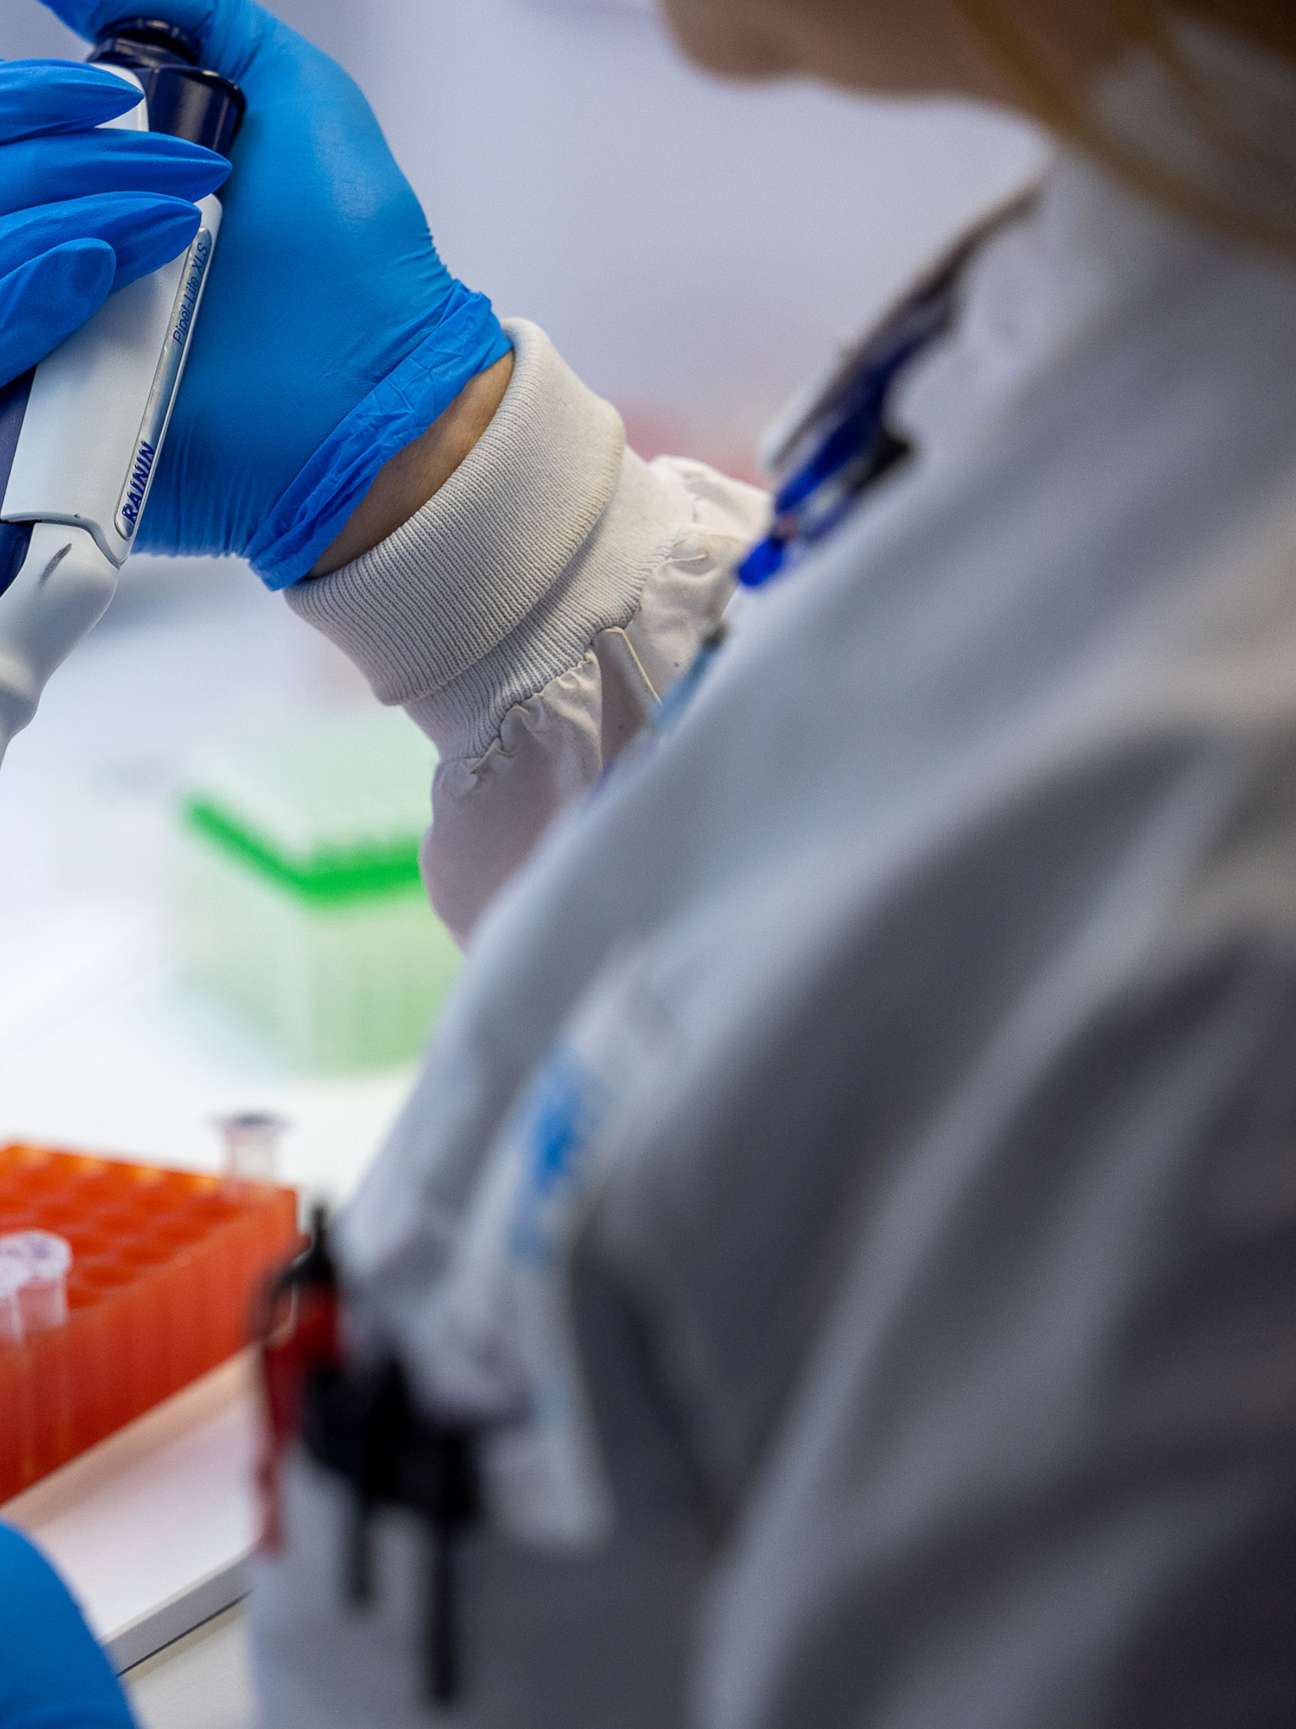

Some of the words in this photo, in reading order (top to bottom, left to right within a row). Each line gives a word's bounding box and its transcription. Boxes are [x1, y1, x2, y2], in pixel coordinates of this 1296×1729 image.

[173, 276, 199, 345] Pipet-Lite
[191, 242, 208, 272] XLS
[122, 440, 154, 524] RAININ
